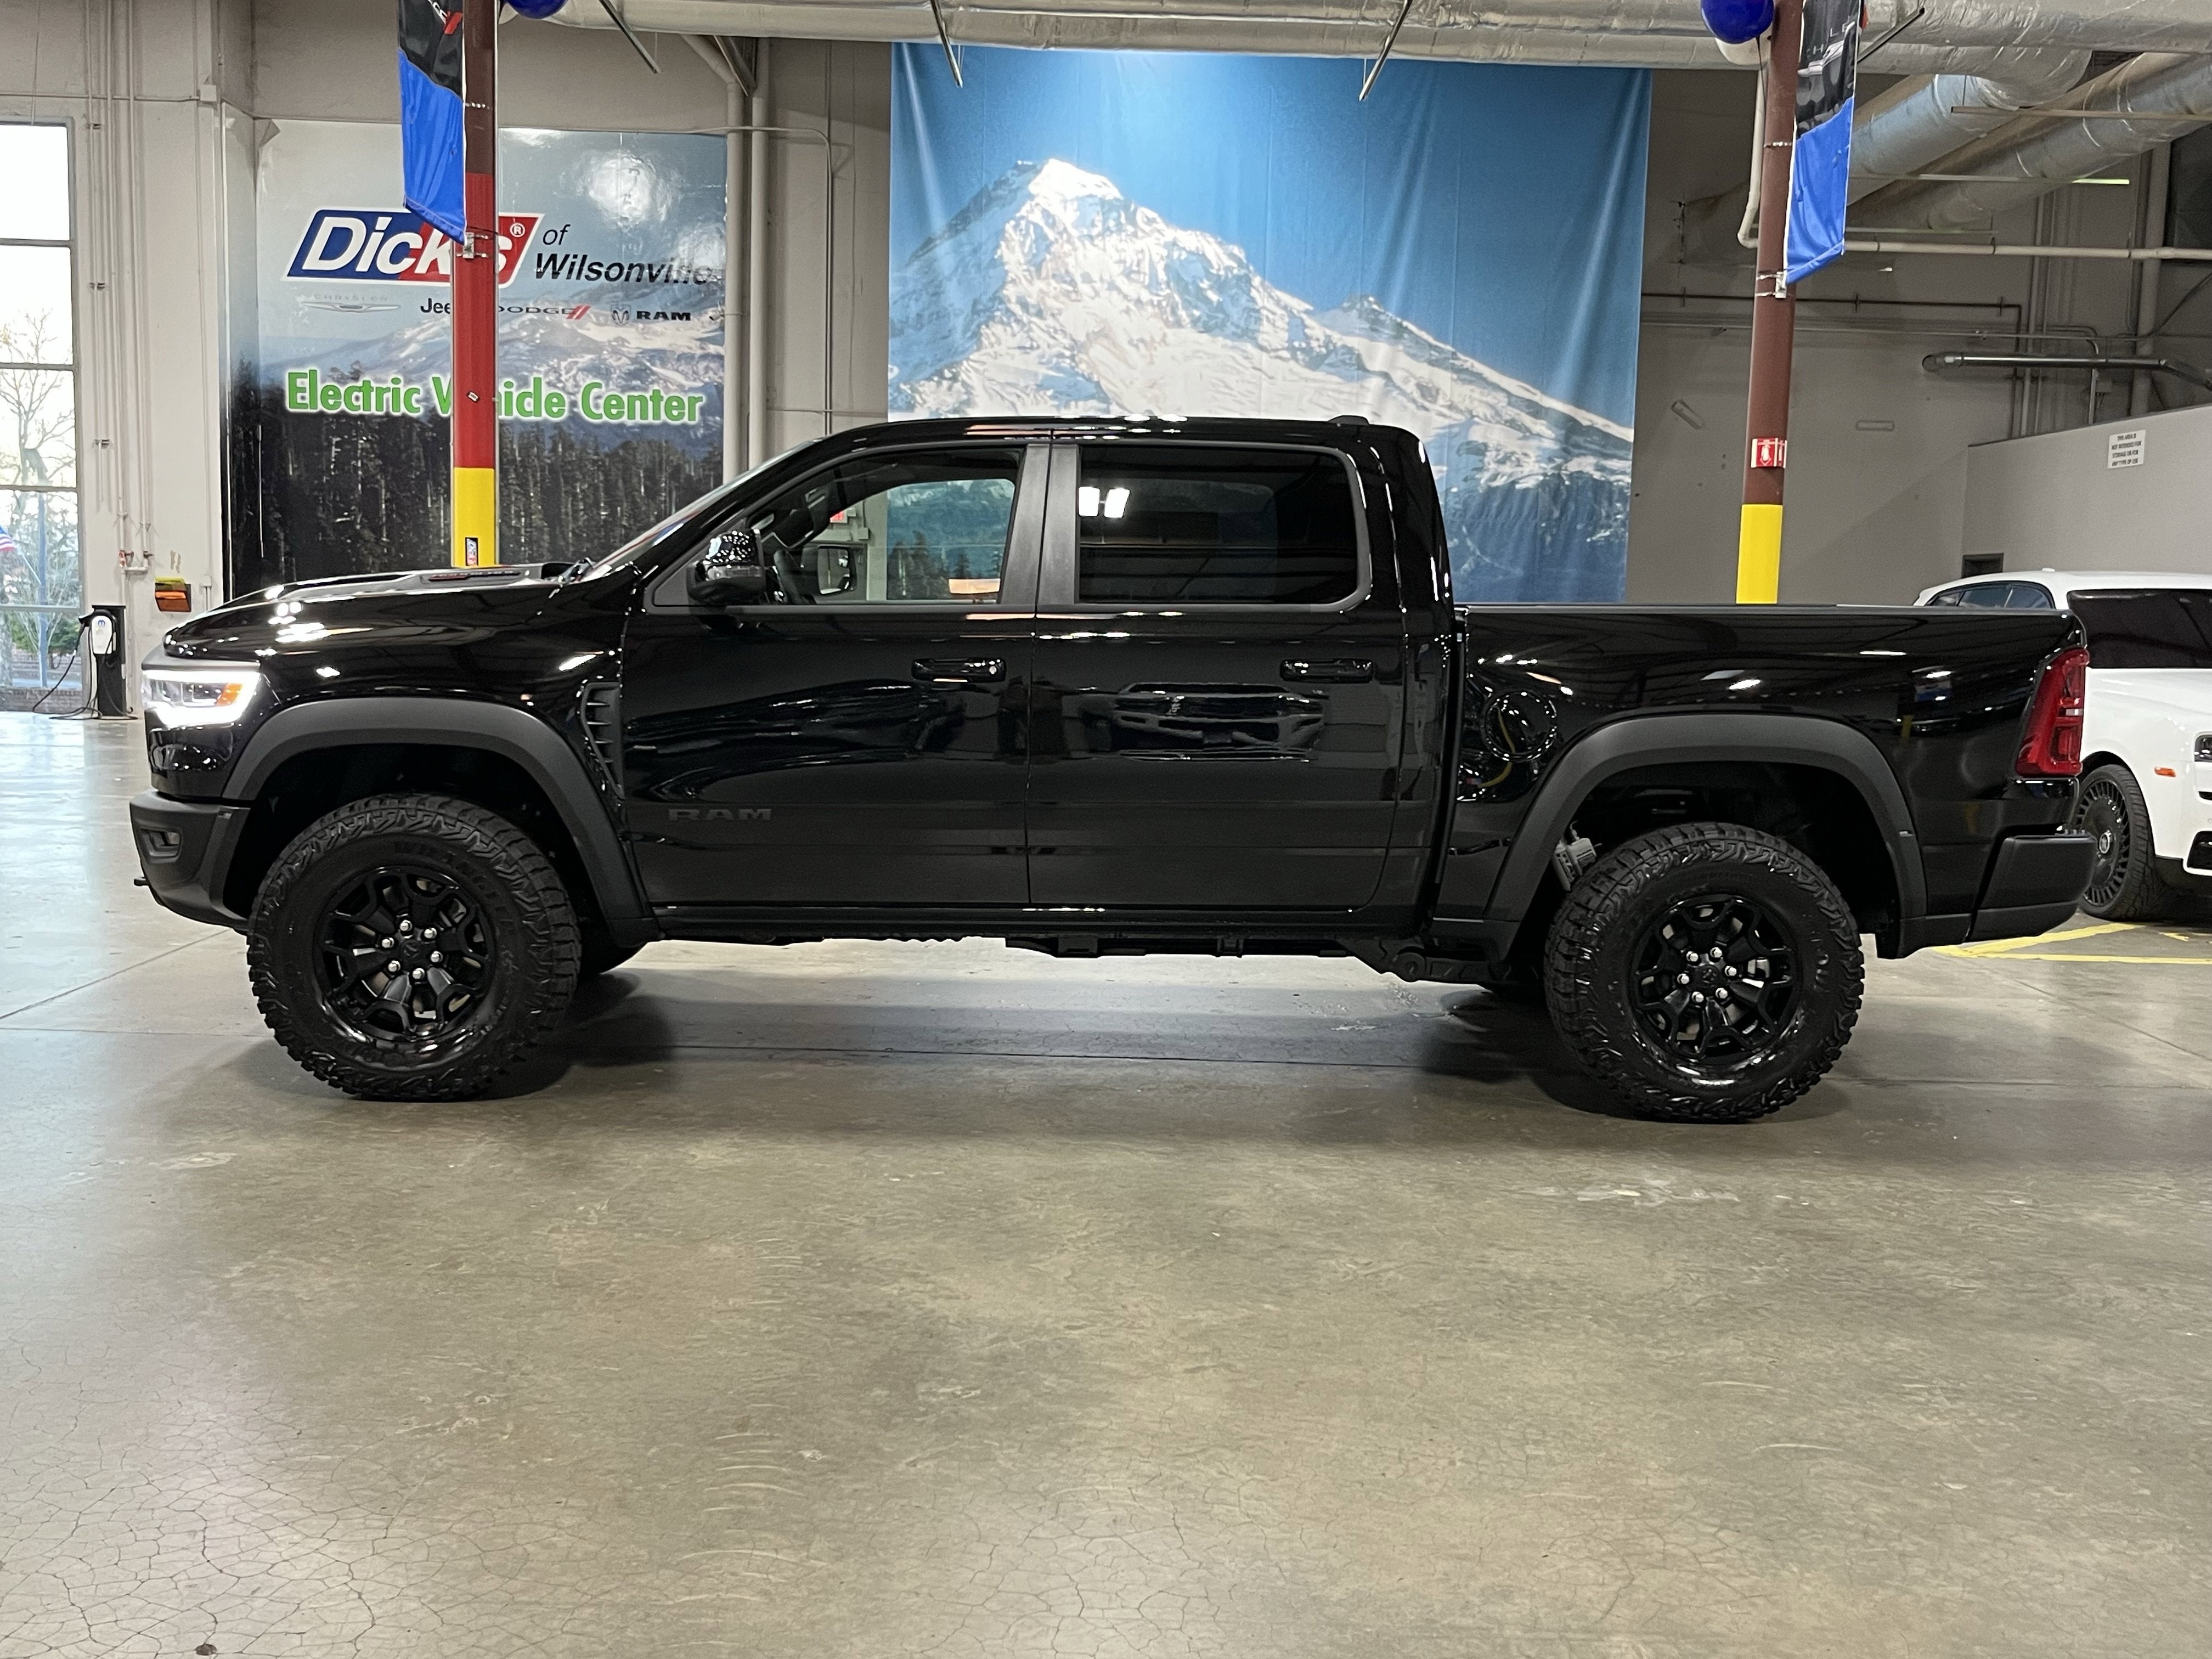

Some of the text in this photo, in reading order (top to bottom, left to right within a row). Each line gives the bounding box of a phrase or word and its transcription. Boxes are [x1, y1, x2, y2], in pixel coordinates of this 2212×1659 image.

[302, 216, 571, 275] Dick of
[420, 297, 451, 314] Jee
[636, 311, 691, 321] RAM
[288, 369, 703, 422] Electric Vicle Center
[668, 808, 772, 821] RAM
